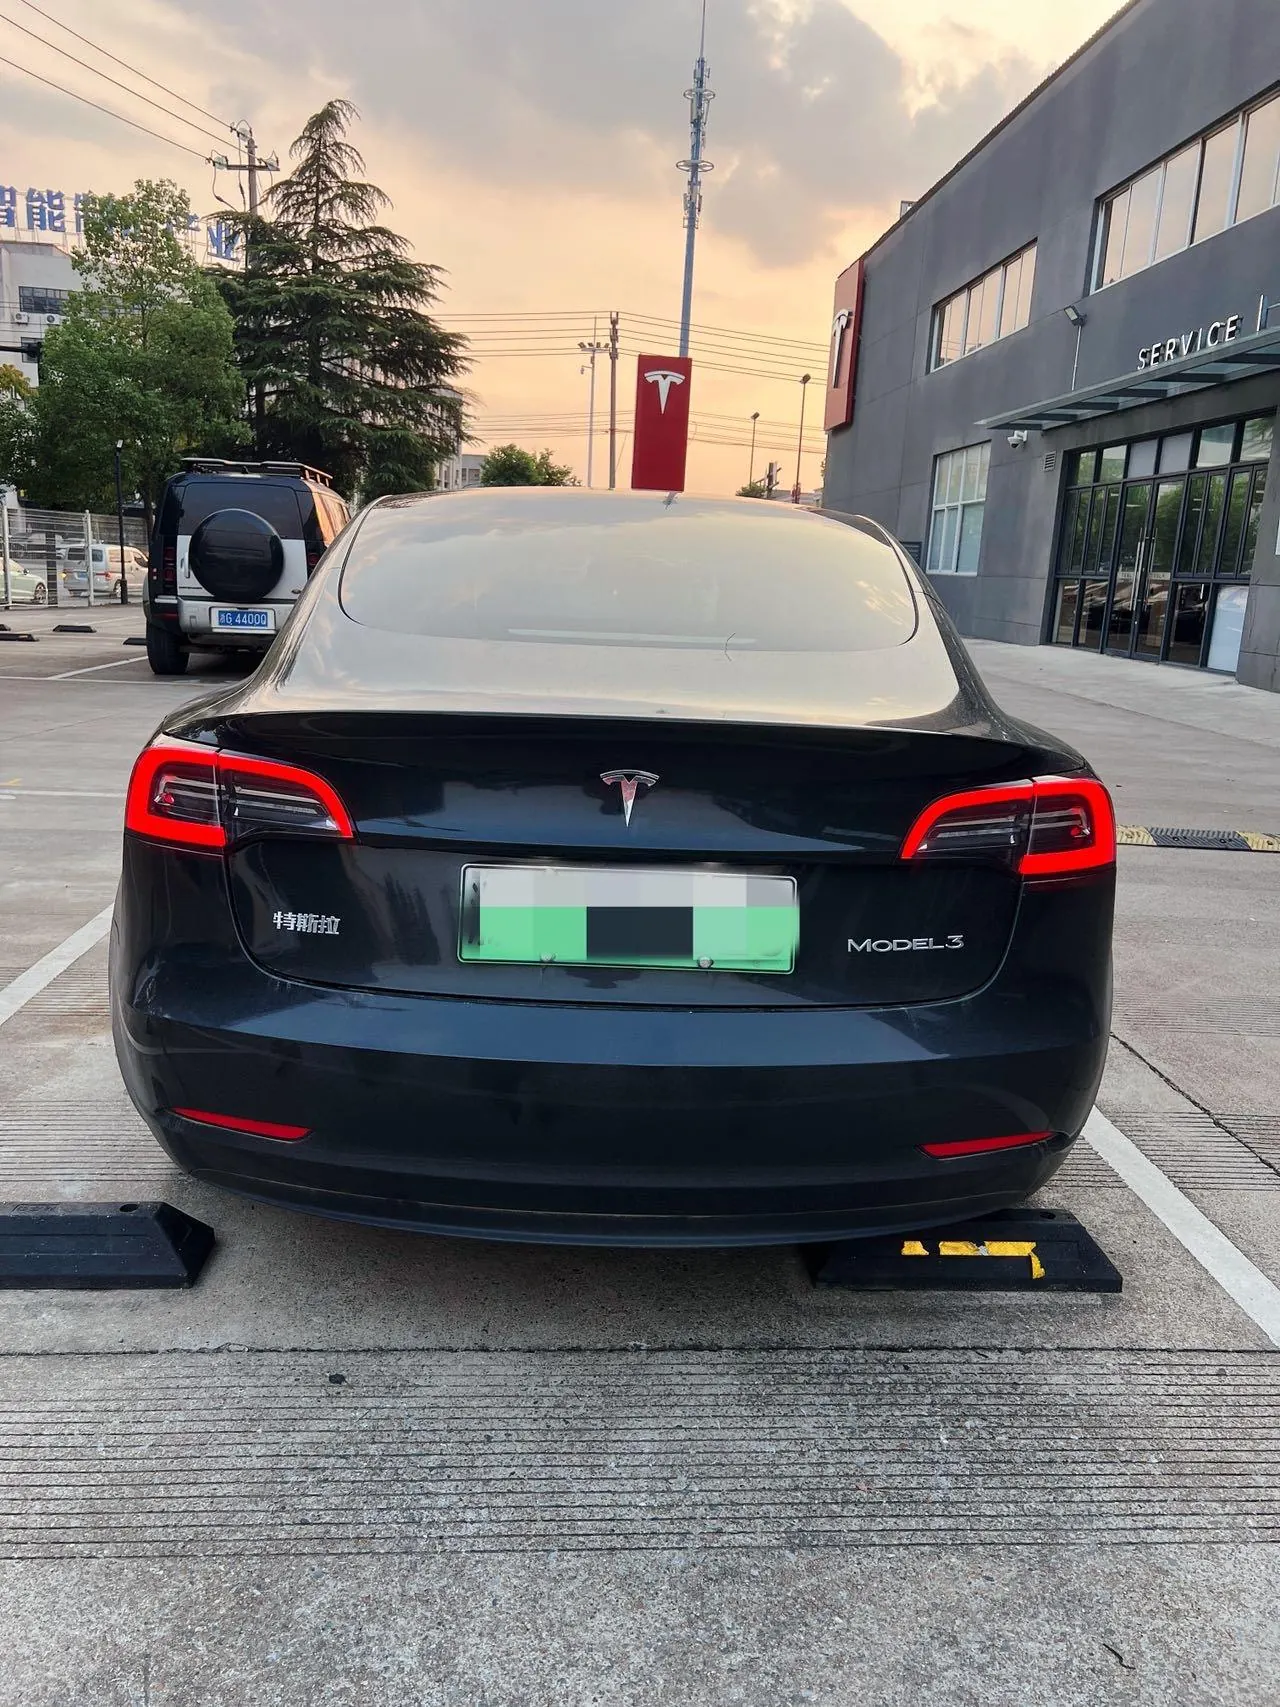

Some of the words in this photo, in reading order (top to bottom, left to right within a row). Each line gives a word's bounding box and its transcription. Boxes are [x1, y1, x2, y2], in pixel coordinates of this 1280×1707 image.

[1137, 314, 1240, 371] SERVICE
[273, 911, 340, 935] 特斯拉
